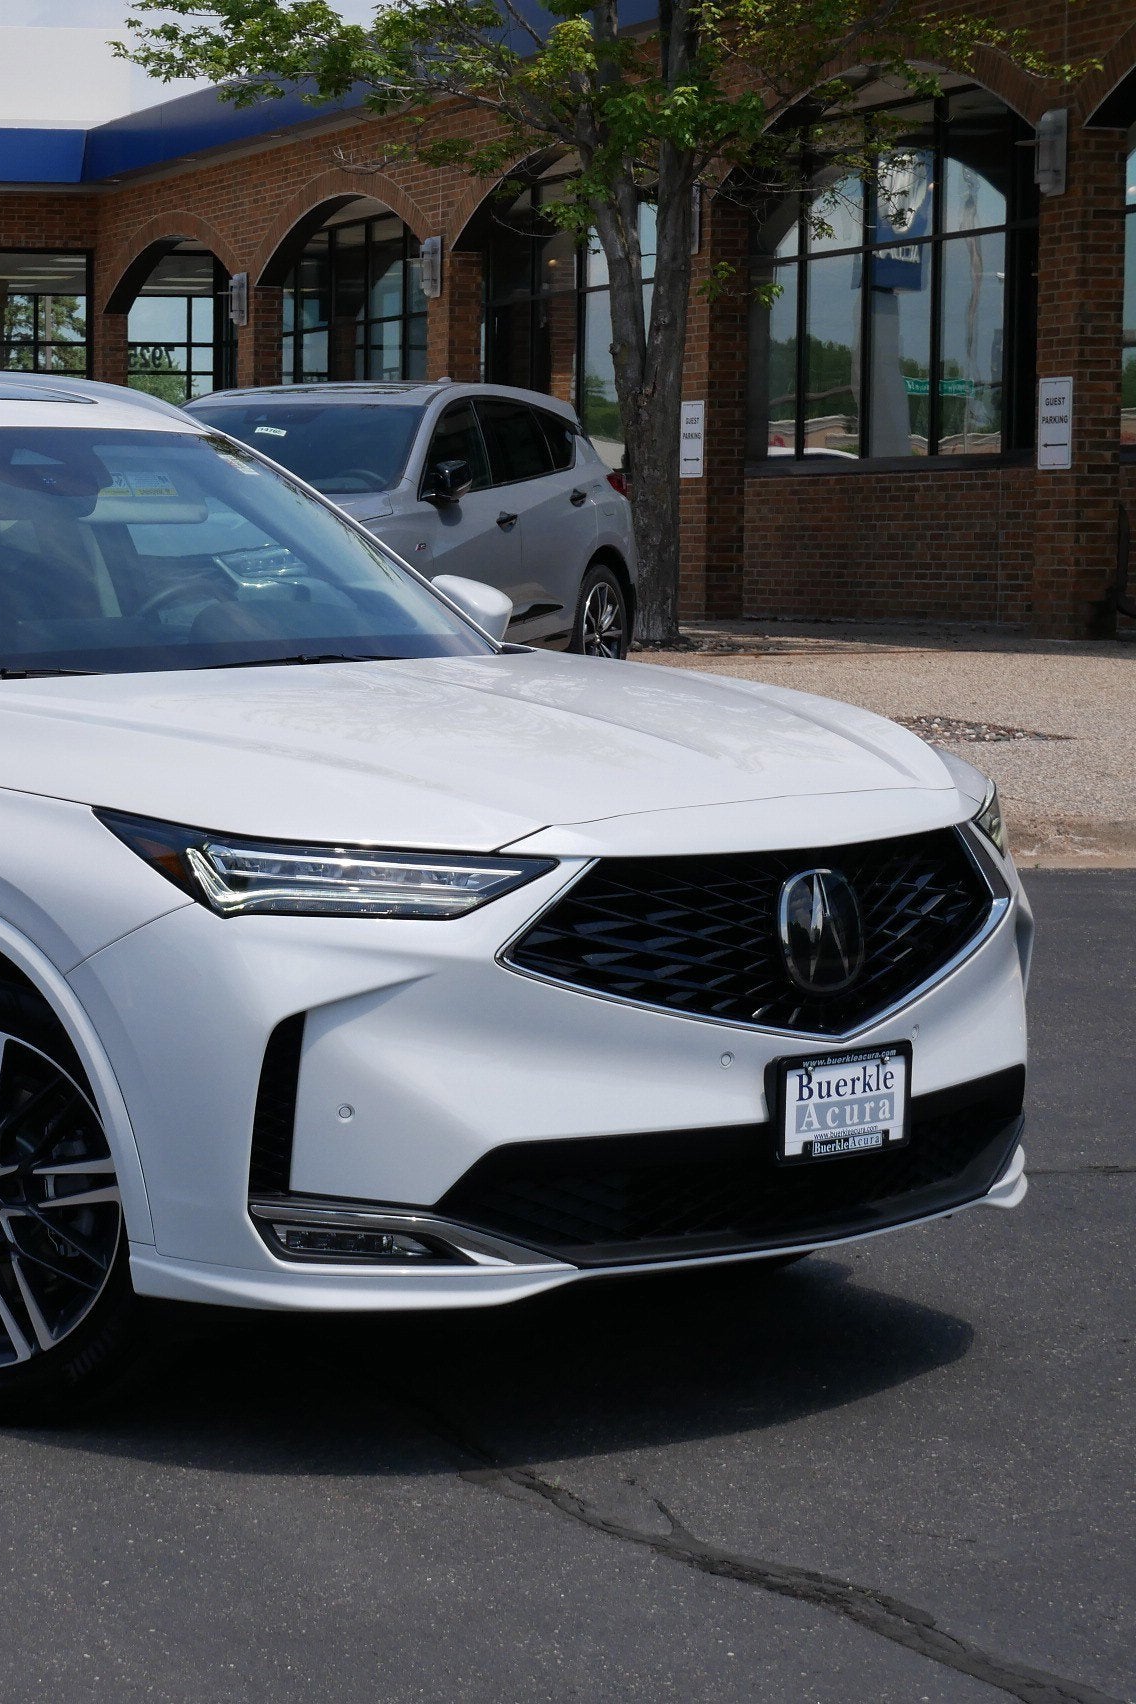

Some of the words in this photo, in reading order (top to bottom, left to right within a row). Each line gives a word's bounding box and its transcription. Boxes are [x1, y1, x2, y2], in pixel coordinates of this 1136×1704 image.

[1045, 397, 1066, 406] GUEST
[1042, 415, 1069, 424] PARKING
[682, 432, 702, 440] PARKING
[802, 1049, 897, 1067] www.buerkleacura.com
[796, 1064, 895, 1101] Buerkle
[799, 1099, 891, 1131] Acura
